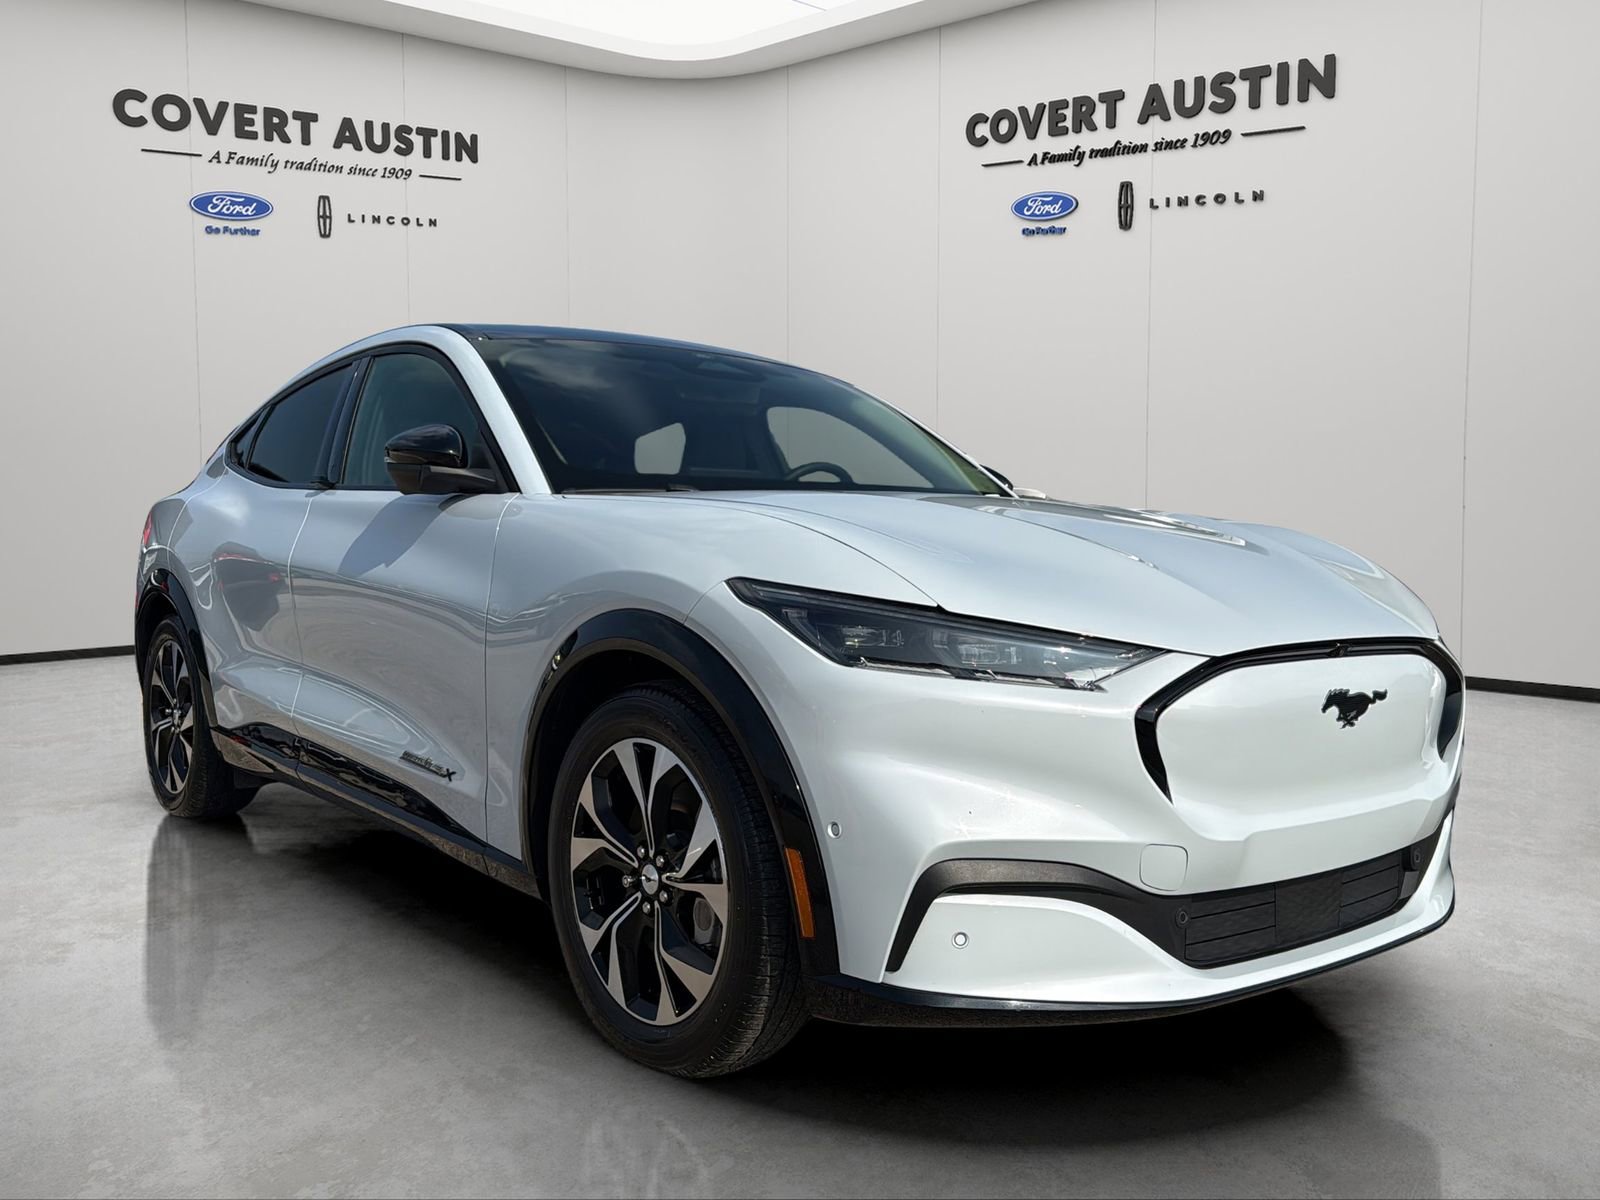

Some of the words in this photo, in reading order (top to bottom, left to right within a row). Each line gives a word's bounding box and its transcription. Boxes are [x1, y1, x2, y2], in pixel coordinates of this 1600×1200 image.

[965, 89, 1126, 148] COVERT
[1137, 53, 1338, 126] AUSTIN
[112, 88, 319, 146] COVERT
[332, 116, 479, 164] AUSTIN
[1026, 152, 1039, 168] A
[1039, 145, 1086, 168] Family
[1088, 140, 1149, 160] tradition
[1151, 137, 1188, 153] since
[1190, 129, 1232, 149] 1909
[207, 150, 222, 165] A
[225, 151, 280, 174] Family
[283, 157, 344, 175] tradition
[347, 164, 379, 178] since
[381, 166, 413, 180] 1909
[207, 195, 257, 216] Ford
[1023, 196, 1062, 216] Ford
[1149, 190, 1265, 211] LINCOLN
[205, 225, 221, 236] Go
[222, 226, 261, 237] Further
[347, 213, 438, 228] LINCOLN
